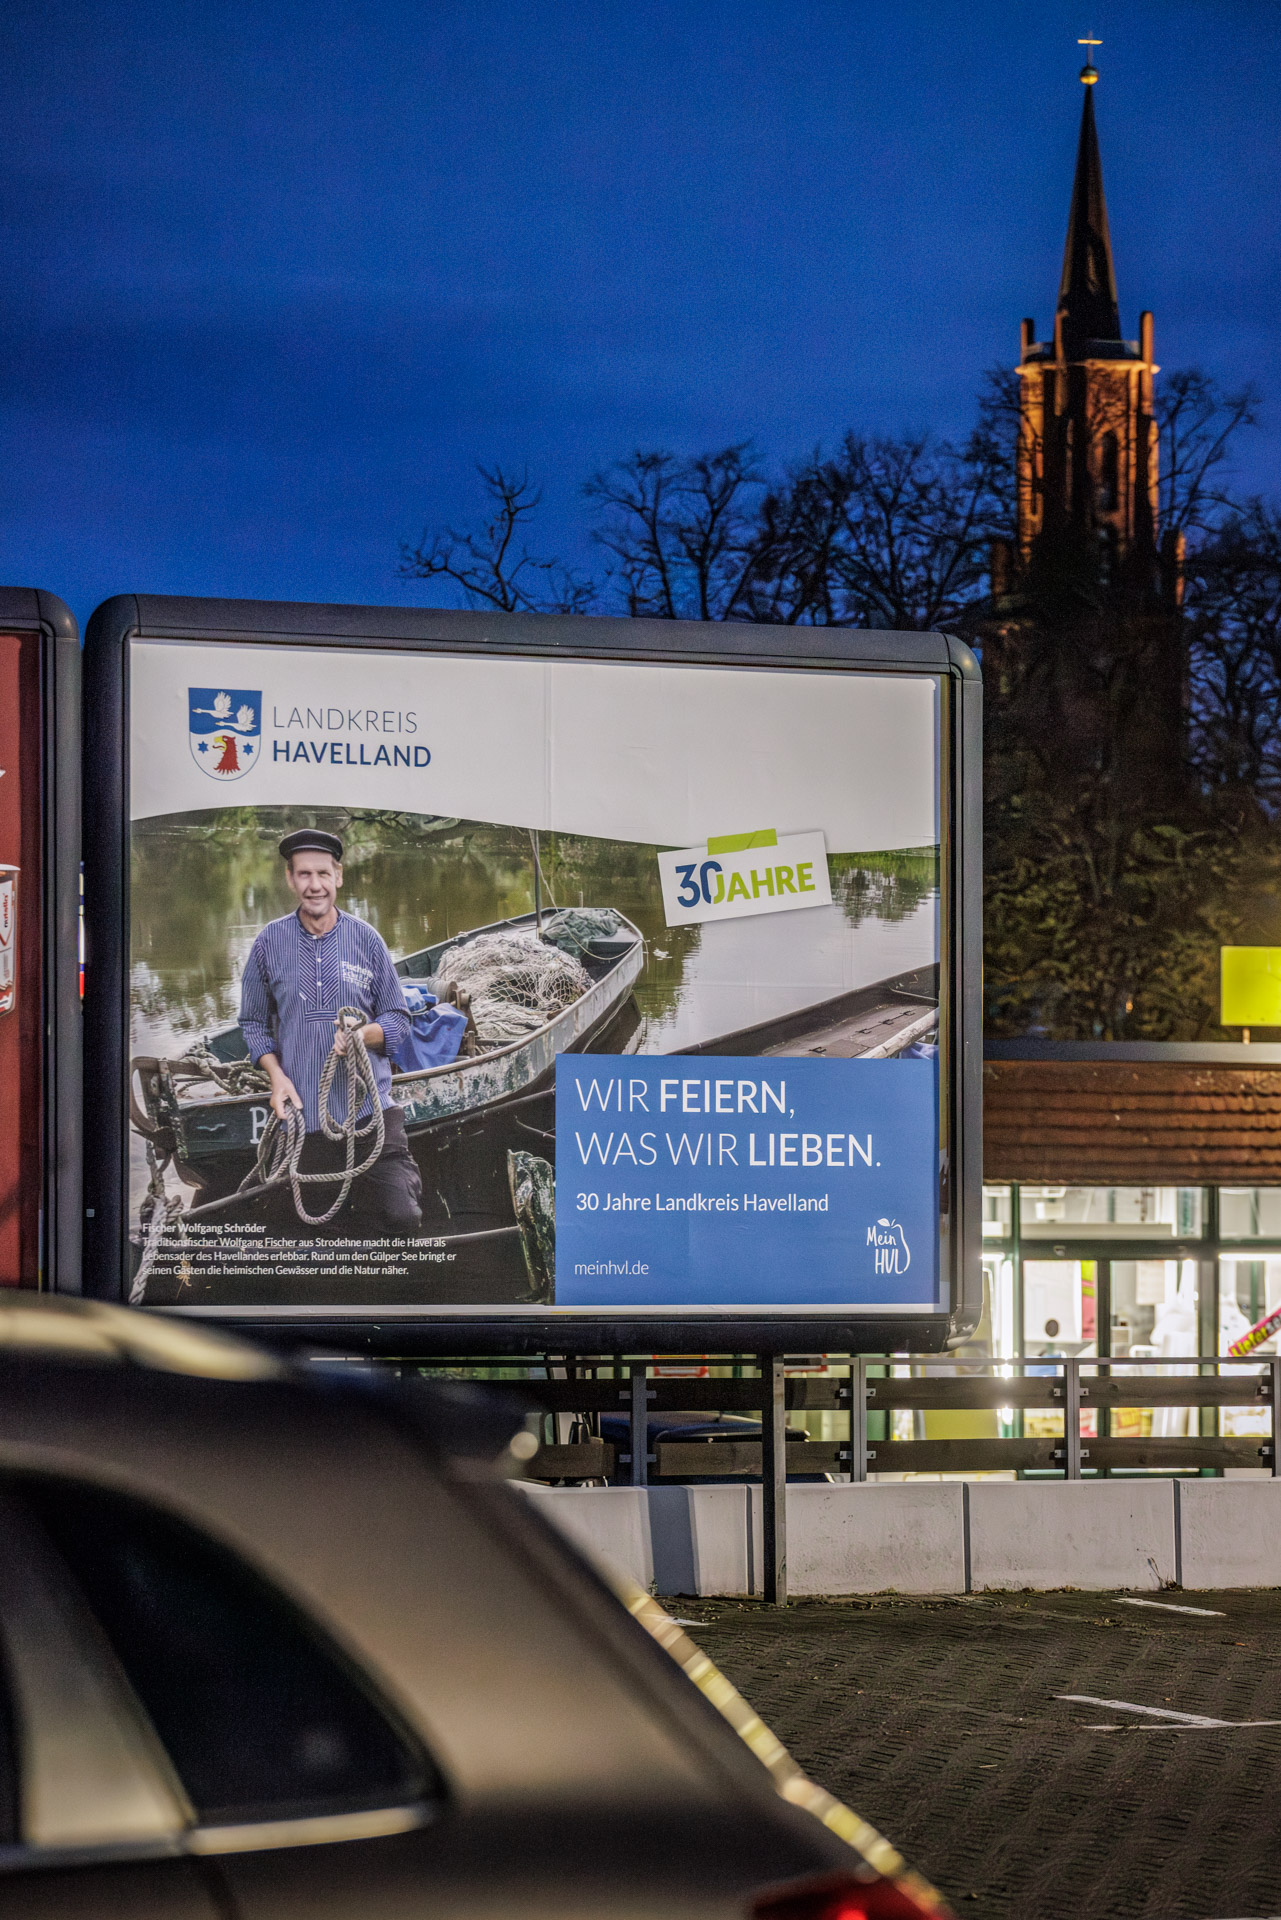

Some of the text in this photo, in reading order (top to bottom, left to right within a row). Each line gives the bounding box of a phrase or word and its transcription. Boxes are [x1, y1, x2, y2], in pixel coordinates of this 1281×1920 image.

[273, 706, 418, 733] LANDKREIS
[273, 740, 432, 768] HAVELLAND
[713, 862, 816, 904] JAHRE
[575, 1079, 795, 1119] WIR FEIERN,
[575, 1132, 881, 1167] WAS WIR LIEBEN.
[575, 1193, 829, 1212] 30 Jahre Landkreis Havelland
[142, 1222, 267, 1235] Fischer Wolfgang Schröder
[866, 1225, 897, 1247] Mein
[142, 1237, 447, 1249] Traditionsfischer Wolfgang Fischer aus Strodehne macht die Havel als
[142, 1251, 196, 1261] Lebensader
[196, 1251, 212, 1261] des
[213, 1251, 269, 1261] Havellandes
[270, 1251, 310, 1261] erlebbar.
[311, 1251, 335, 1261] Rund
[351, 1251, 369, 1261] den
[369, 1251, 401, 1263] Gülper
[401, 1251, 418, 1261] See
[419, 1251, 446, 1263] bringt
[575, 1261, 649, 1275] meinhvl.de
[875, 1248, 904, 1275] HVL
[142, 1265, 409, 1275] seinen Gästen die heimischen Gewässer und die Natur näher.
